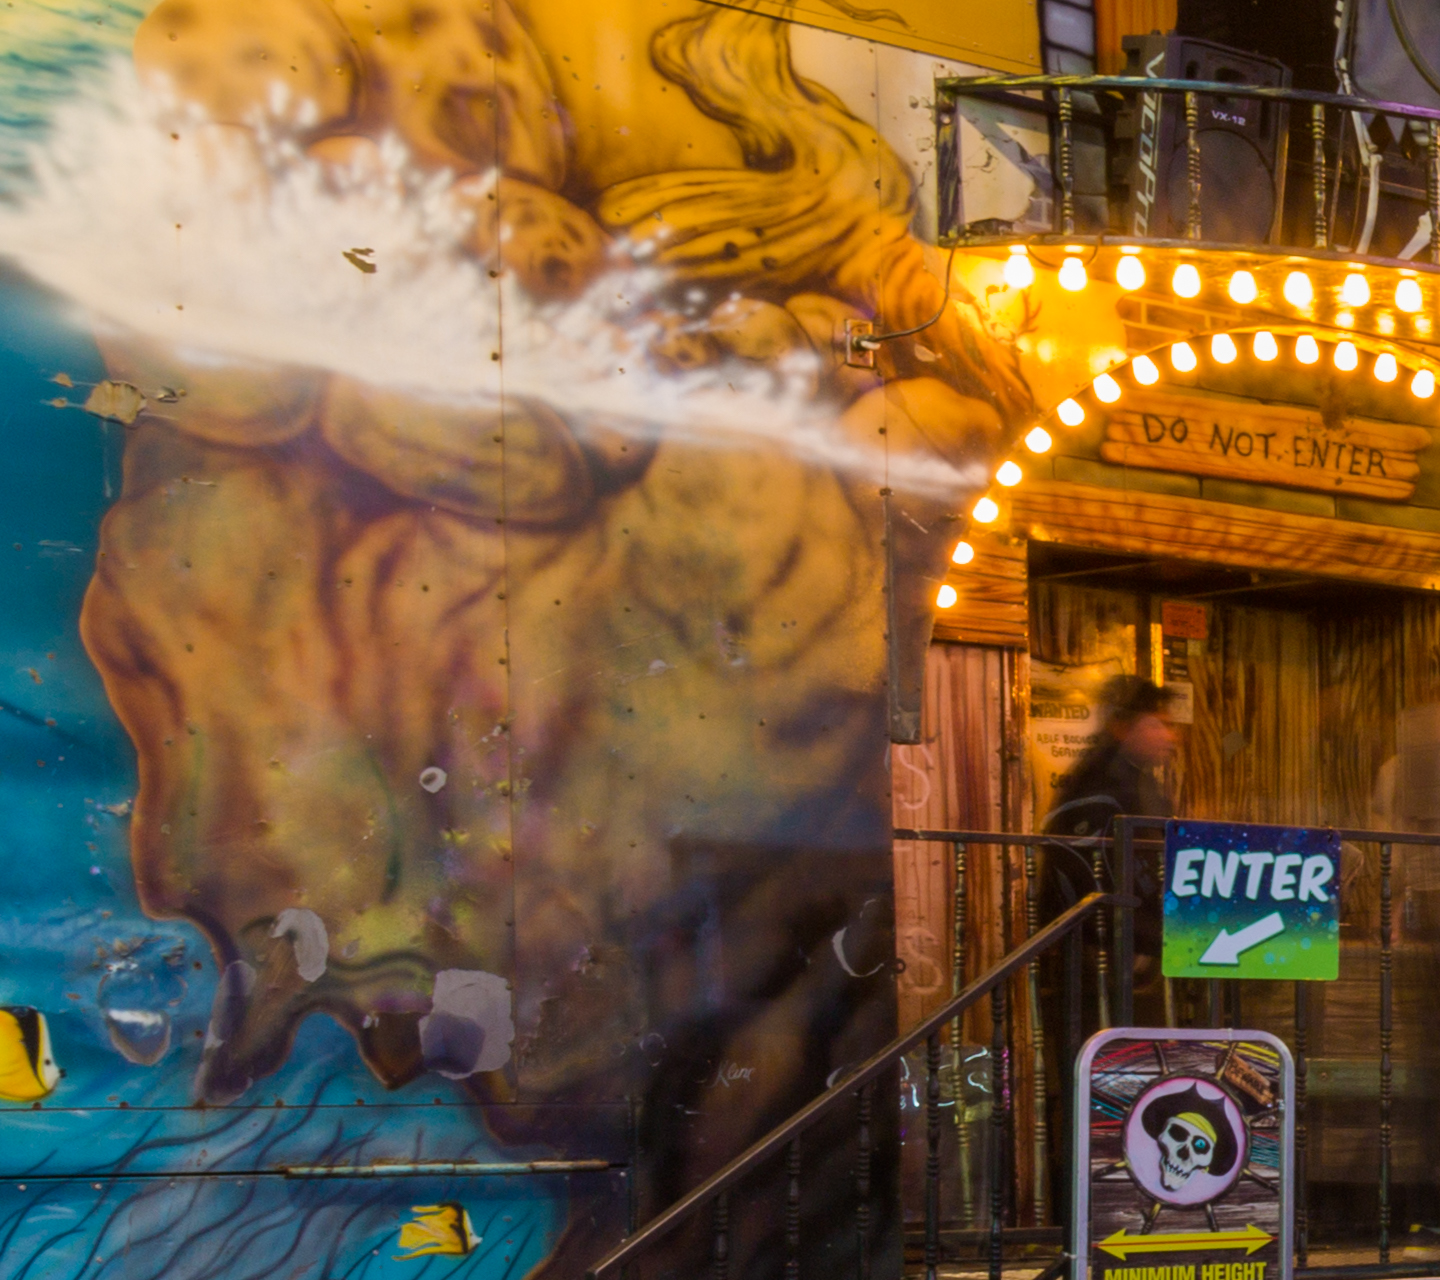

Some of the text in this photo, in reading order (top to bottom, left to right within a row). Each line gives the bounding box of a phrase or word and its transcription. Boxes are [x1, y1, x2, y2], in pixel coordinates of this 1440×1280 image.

[1141, 413, 1387, 477] DO NOT ENTER
[1171, 847, 1335, 903] ENTER
